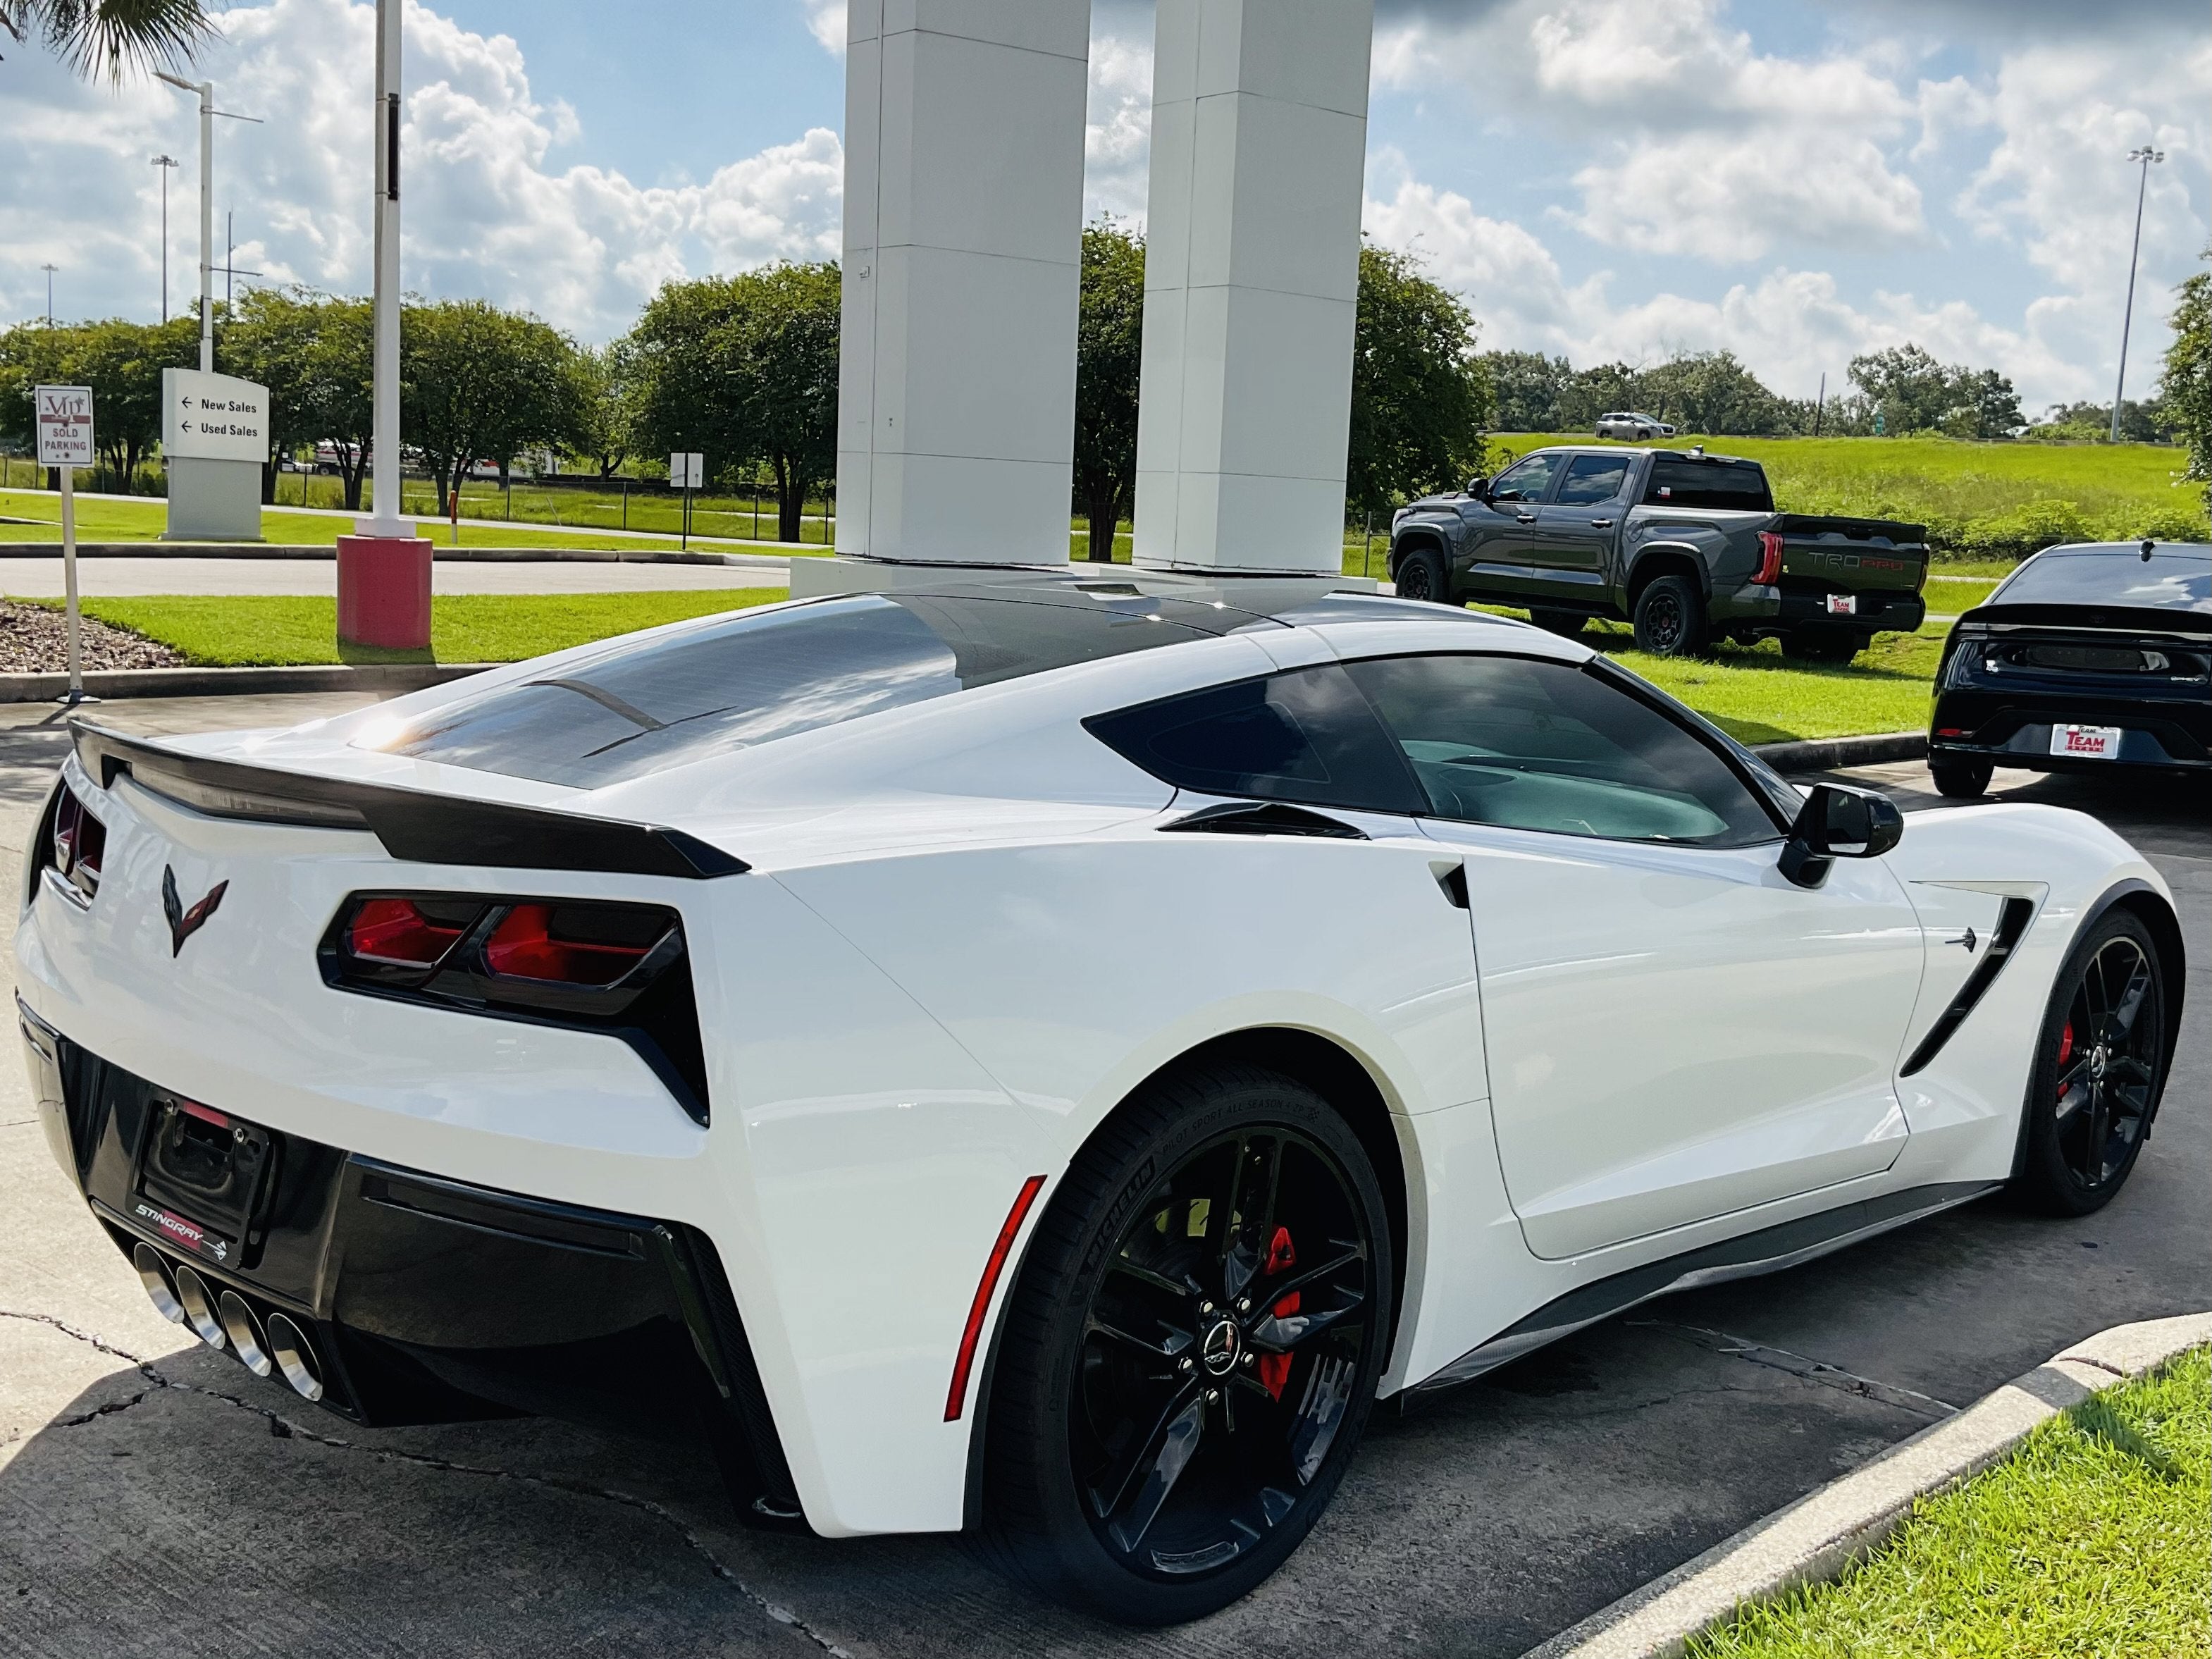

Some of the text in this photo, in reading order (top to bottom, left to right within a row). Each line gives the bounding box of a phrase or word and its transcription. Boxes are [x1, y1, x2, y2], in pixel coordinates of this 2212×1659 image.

[202, 399, 257, 413] New Sales
[53, 428, 78, 437] SOLD
[202, 423, 258, 437] Used Sales
[45, 441, 86, 450] PARKING
[2066, 732, 2105, 747] TEAM
[1163, 1129, 1188, 1154] PILOT
[1192, 1110, 1222, 1130] SPORT
[1227, 1103, 1243, 1113] ALL
[1247, 1099, 1284, 1109] SEASON
[135, 1204, 204, 1240] STINGRAY
[1087, 1162, 1152, 1269] MICHELIN
